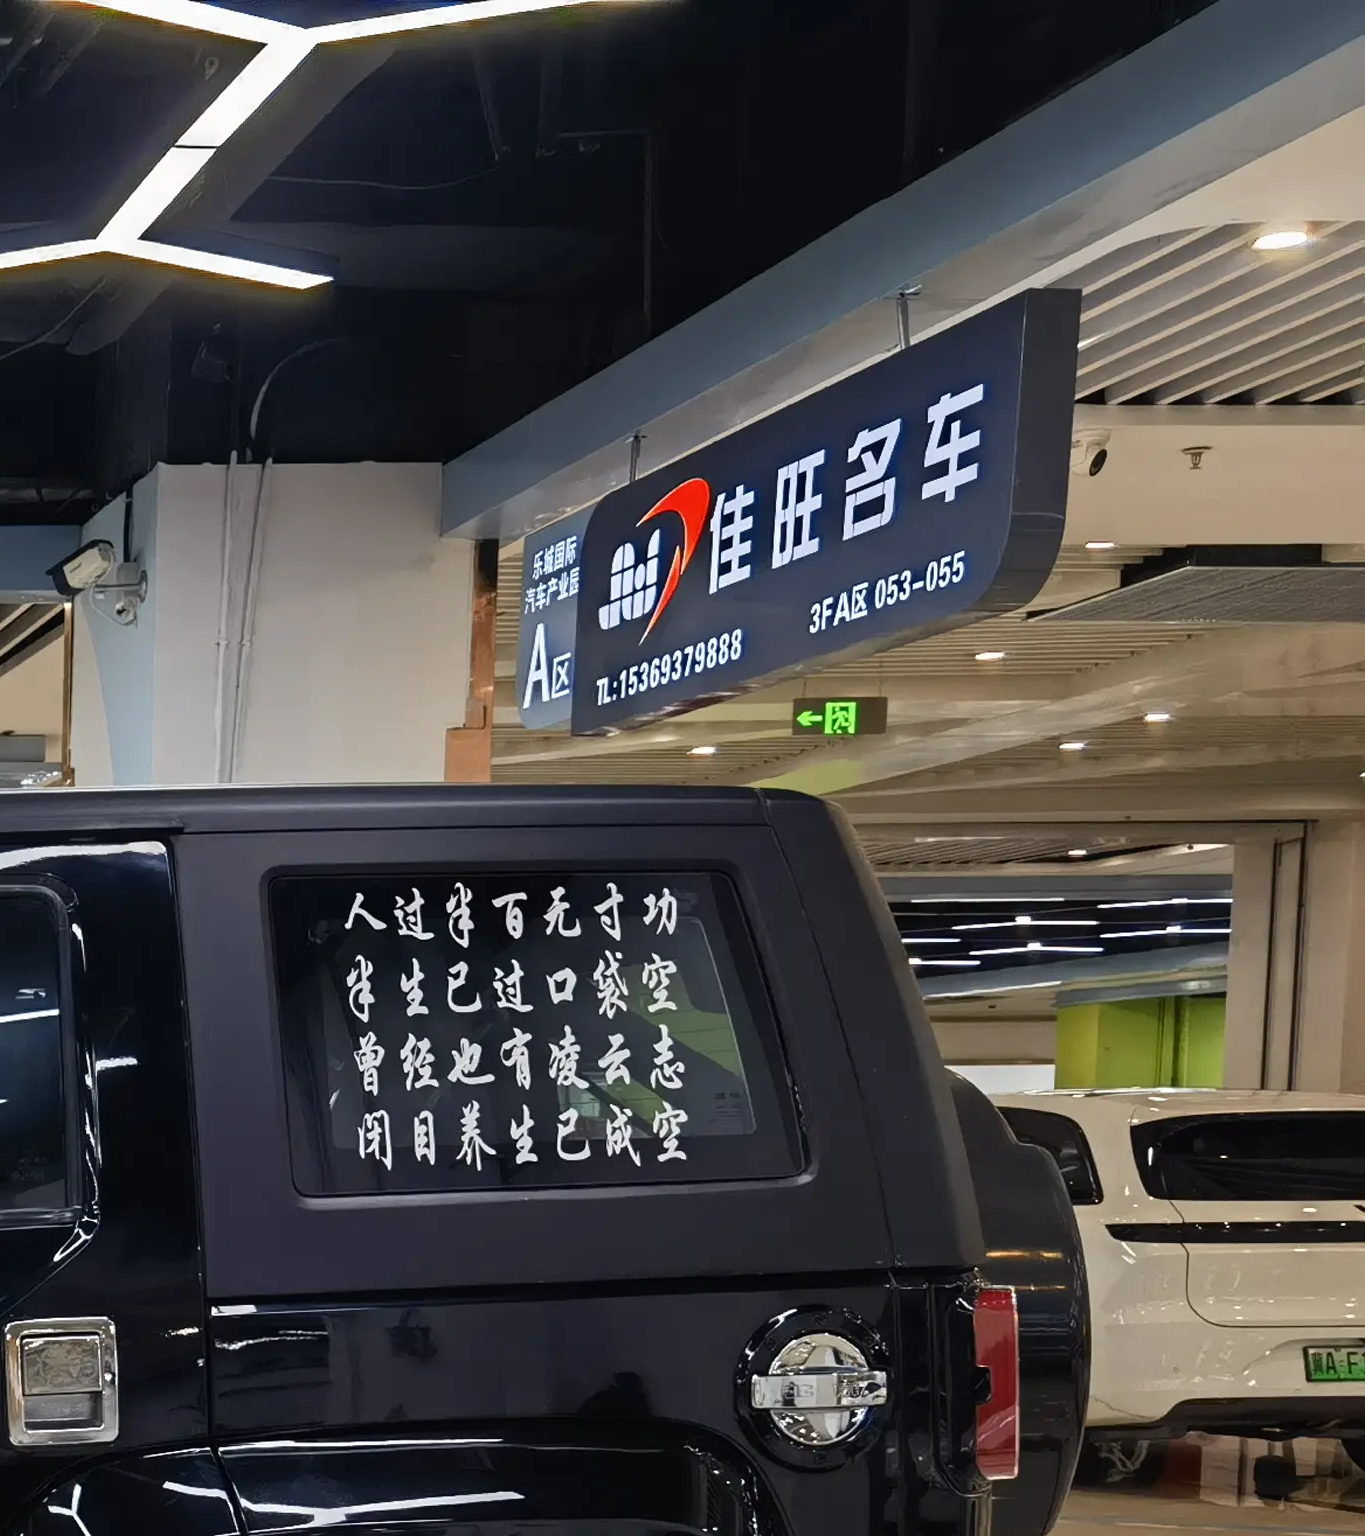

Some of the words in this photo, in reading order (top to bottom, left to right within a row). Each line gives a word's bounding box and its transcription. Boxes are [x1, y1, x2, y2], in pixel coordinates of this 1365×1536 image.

[709, 383, 984, 595] 佳旺名车
[524, 567, 580, 615] 汽车产业园
[532, 535, 578, 581] 乐城国际
[809, 582, 869, 634] 3FA区
[874, 550, 966, 612] 053-055
[522, 622, 572, 710] A区
[344, 881, 678, 948] 人过半百无寸功
[346, 949, 678, 1022] 半生已过口袋空
[352, 1024, 686, 1097] 曾经也有凌云志
